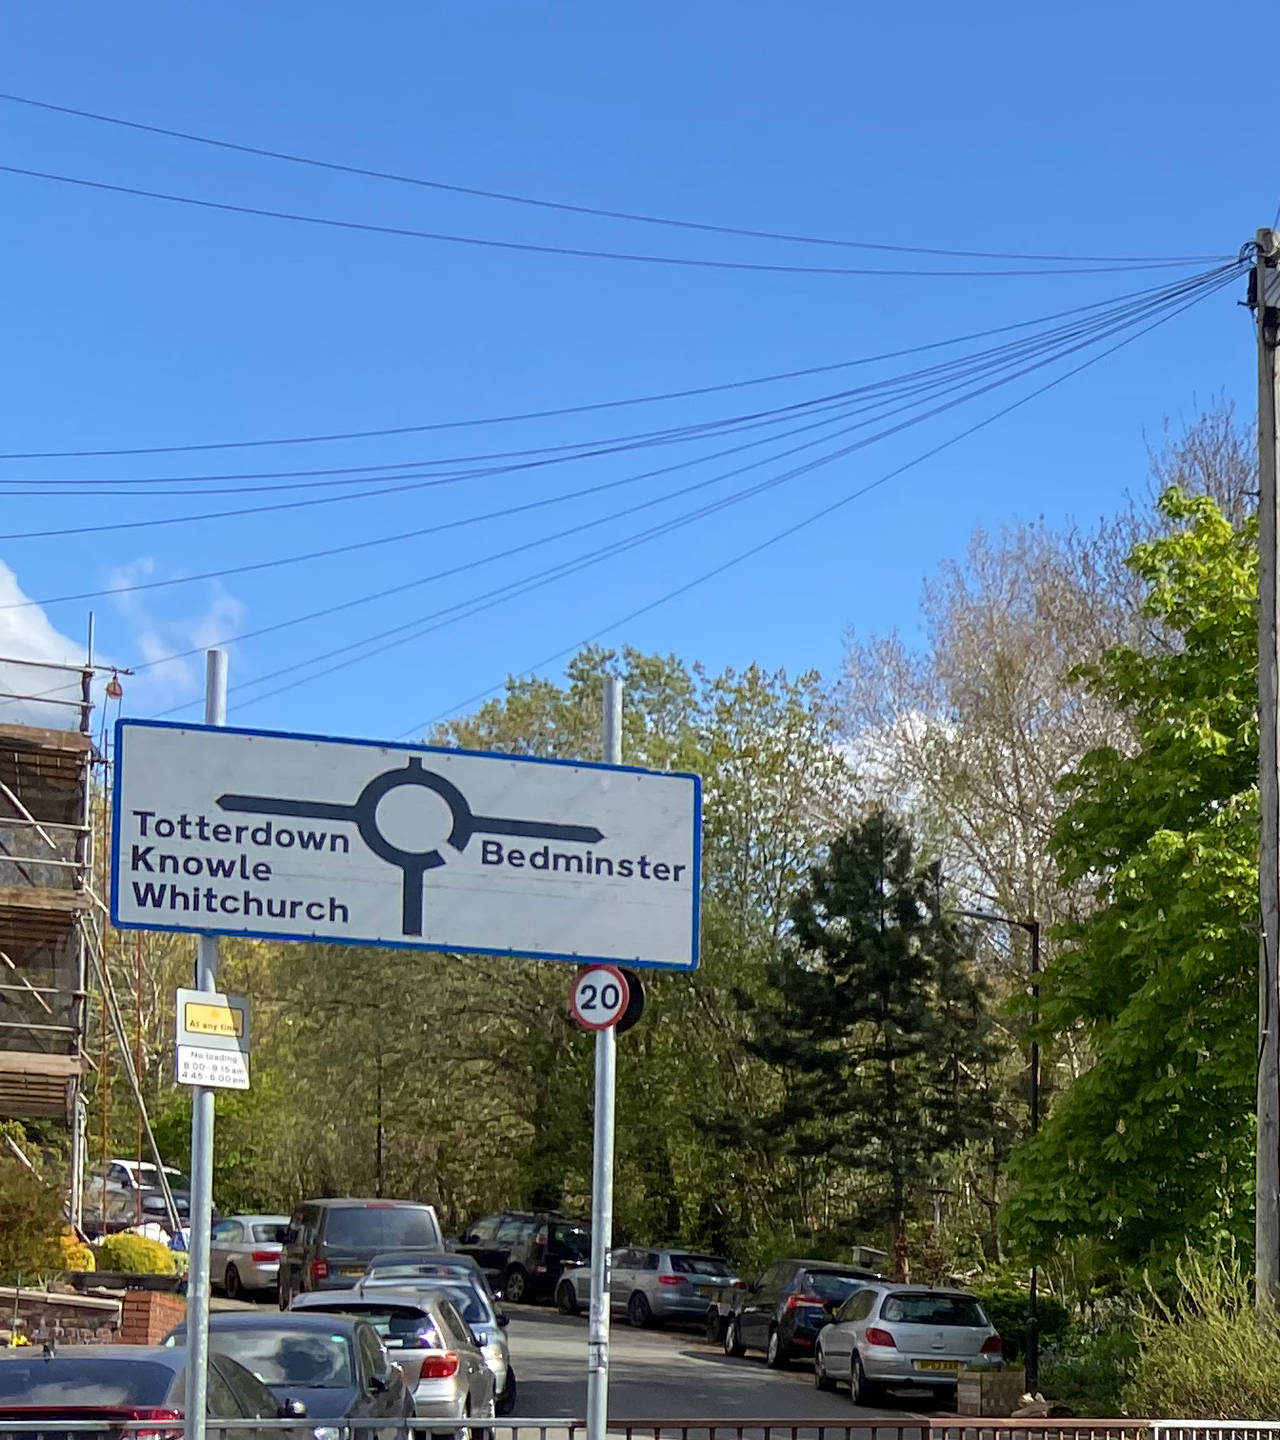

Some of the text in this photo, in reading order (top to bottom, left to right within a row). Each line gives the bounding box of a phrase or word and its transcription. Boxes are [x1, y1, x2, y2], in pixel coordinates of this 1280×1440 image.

[132, 810, 350, 853] Totterdown
[131, 844, 272, 881] Knowle
[481, 839, 686, 882] Bedminster
[132, 881, 349, 923] Whitchurch
[580, 984, 620, 1010] 20
[190, 1019, 200, 1028] At
[202, 1022, 217, 1032] any
[191, 1051, 238, 1064] No loading
